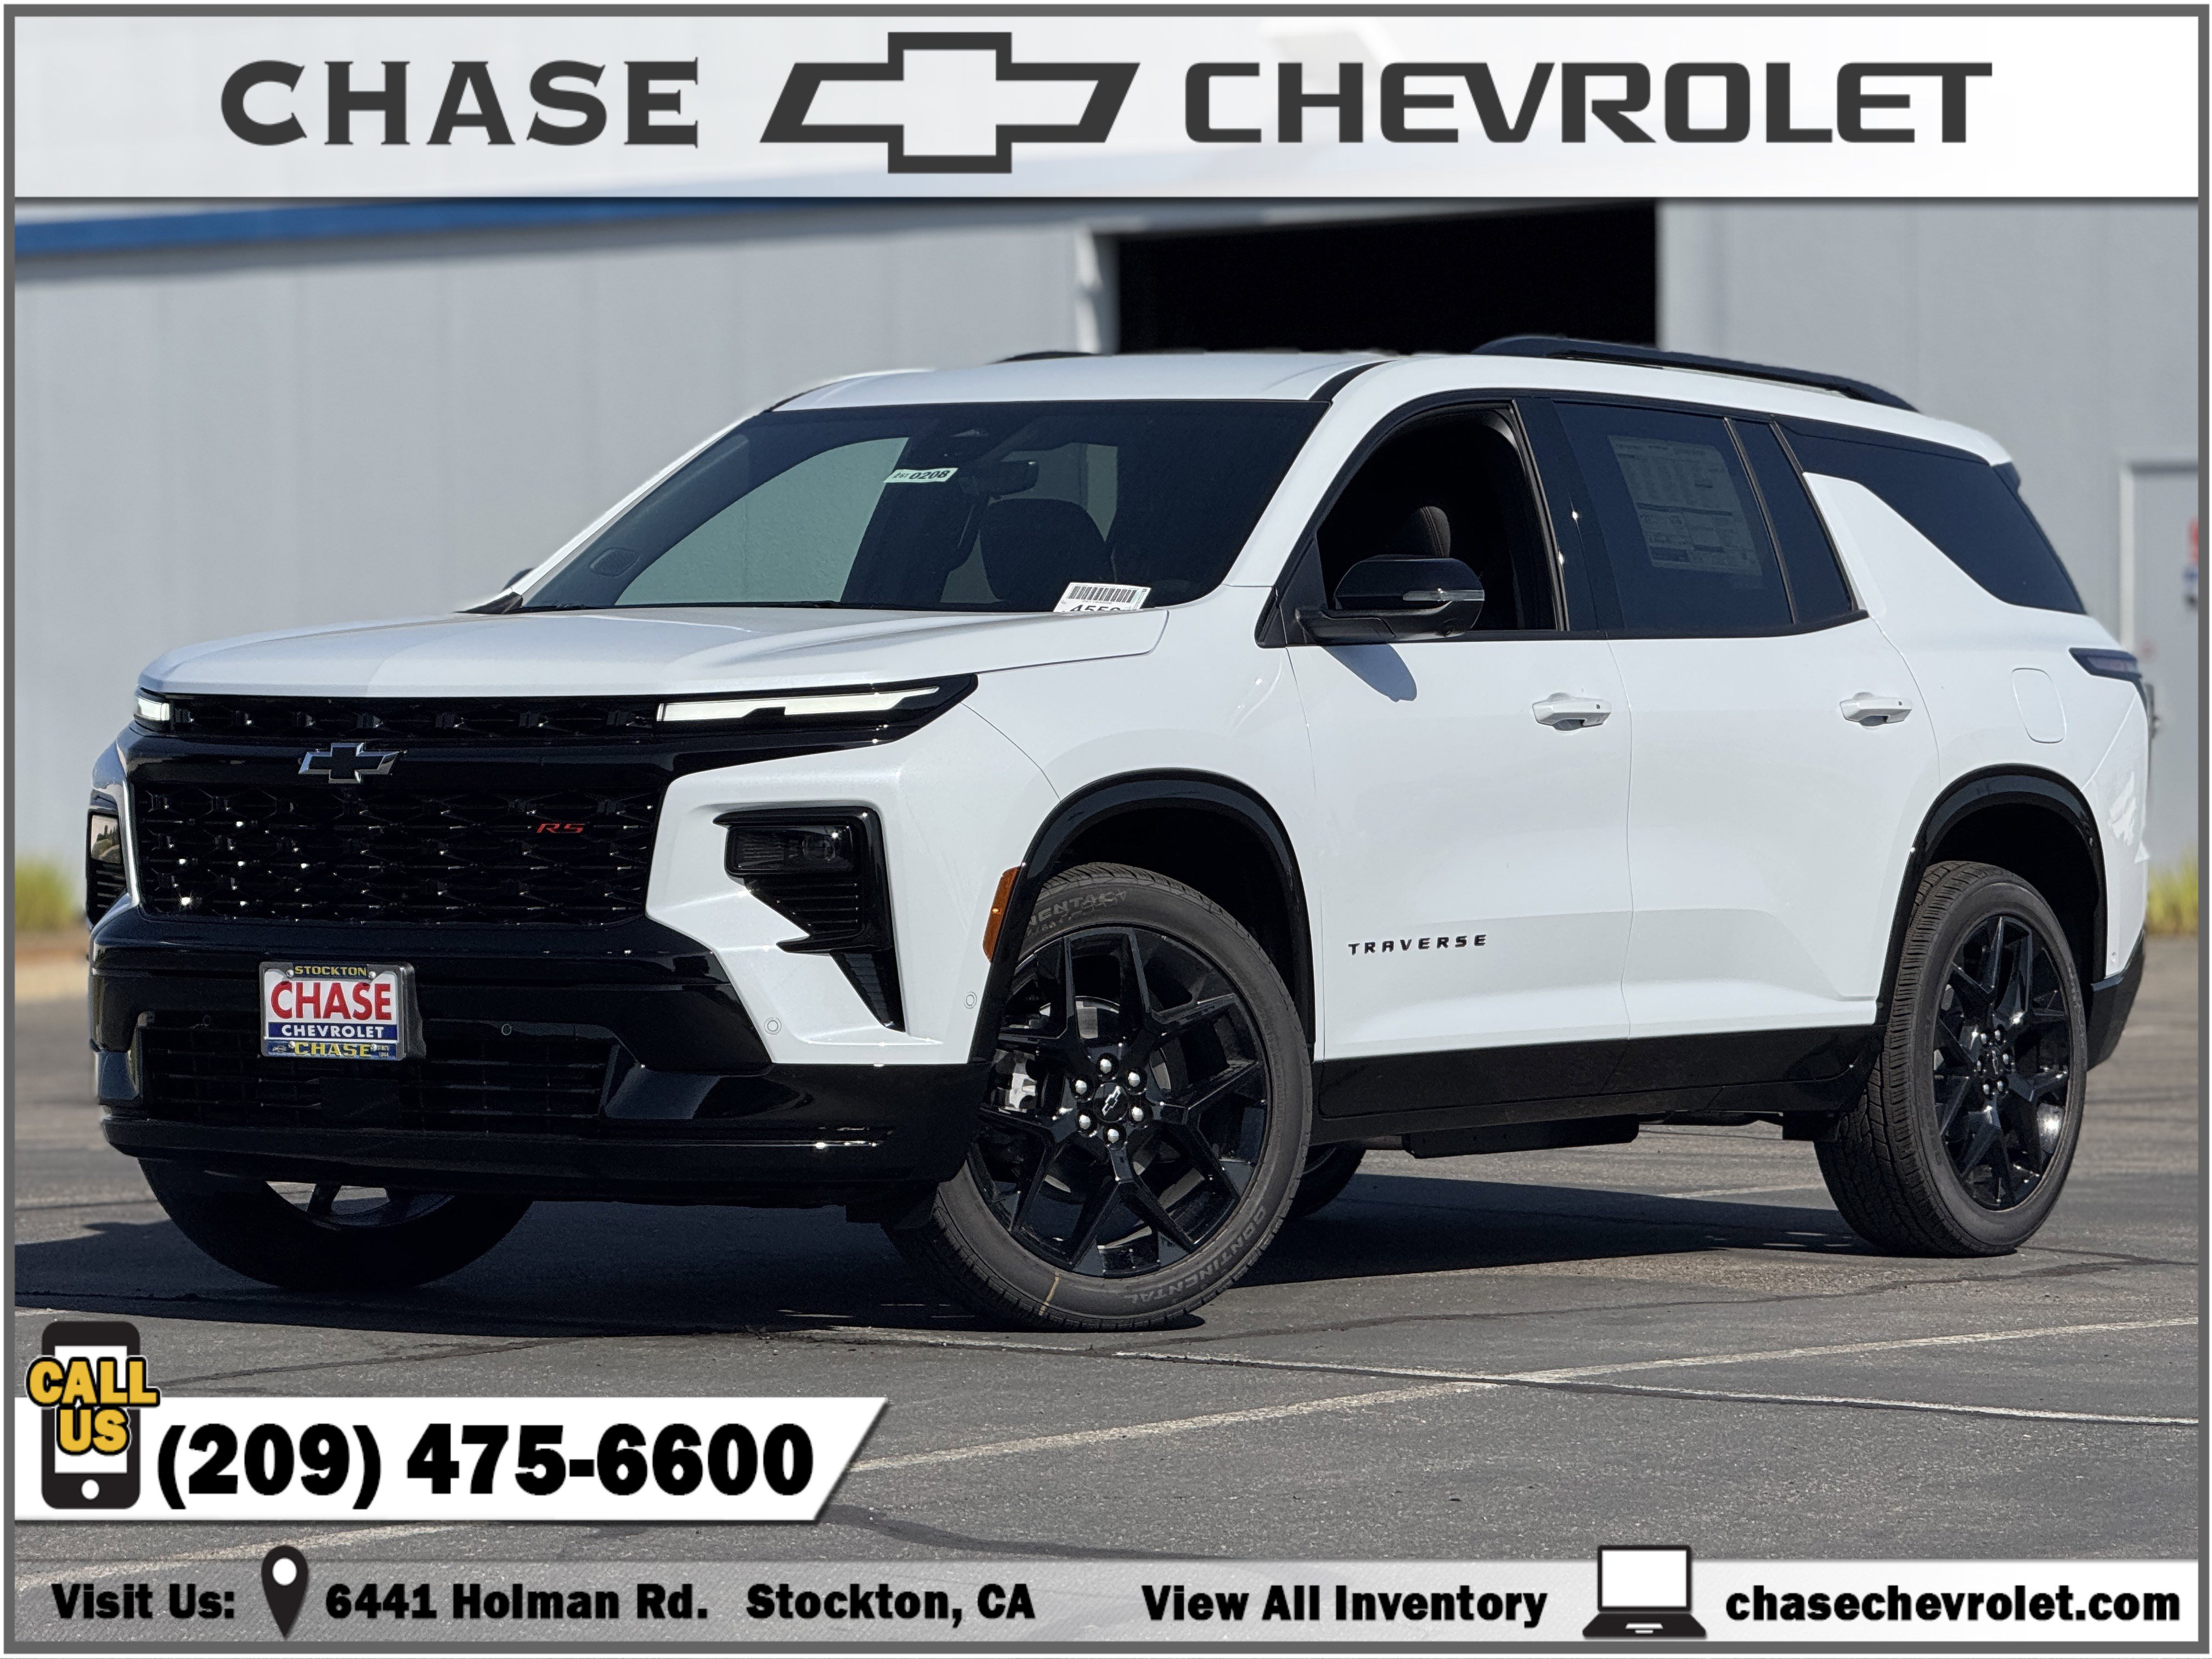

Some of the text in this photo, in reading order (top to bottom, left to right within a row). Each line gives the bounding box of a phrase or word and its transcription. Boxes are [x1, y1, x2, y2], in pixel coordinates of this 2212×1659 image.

[909, 470, 951, 479] 0208
[537, 823, 585, 833] RS
[1348, 934, 1487, 956] TRAVERSE
[294, 966, 366, 977] STOCKTON
[271, 981, 392, 1020] CHASE
[281, 1024, 384, 1039] CHEVROLET
[294, 1041, 372, 1057] CHASE
[1124, 1205, 1266, 1304] CONTINENTAL
